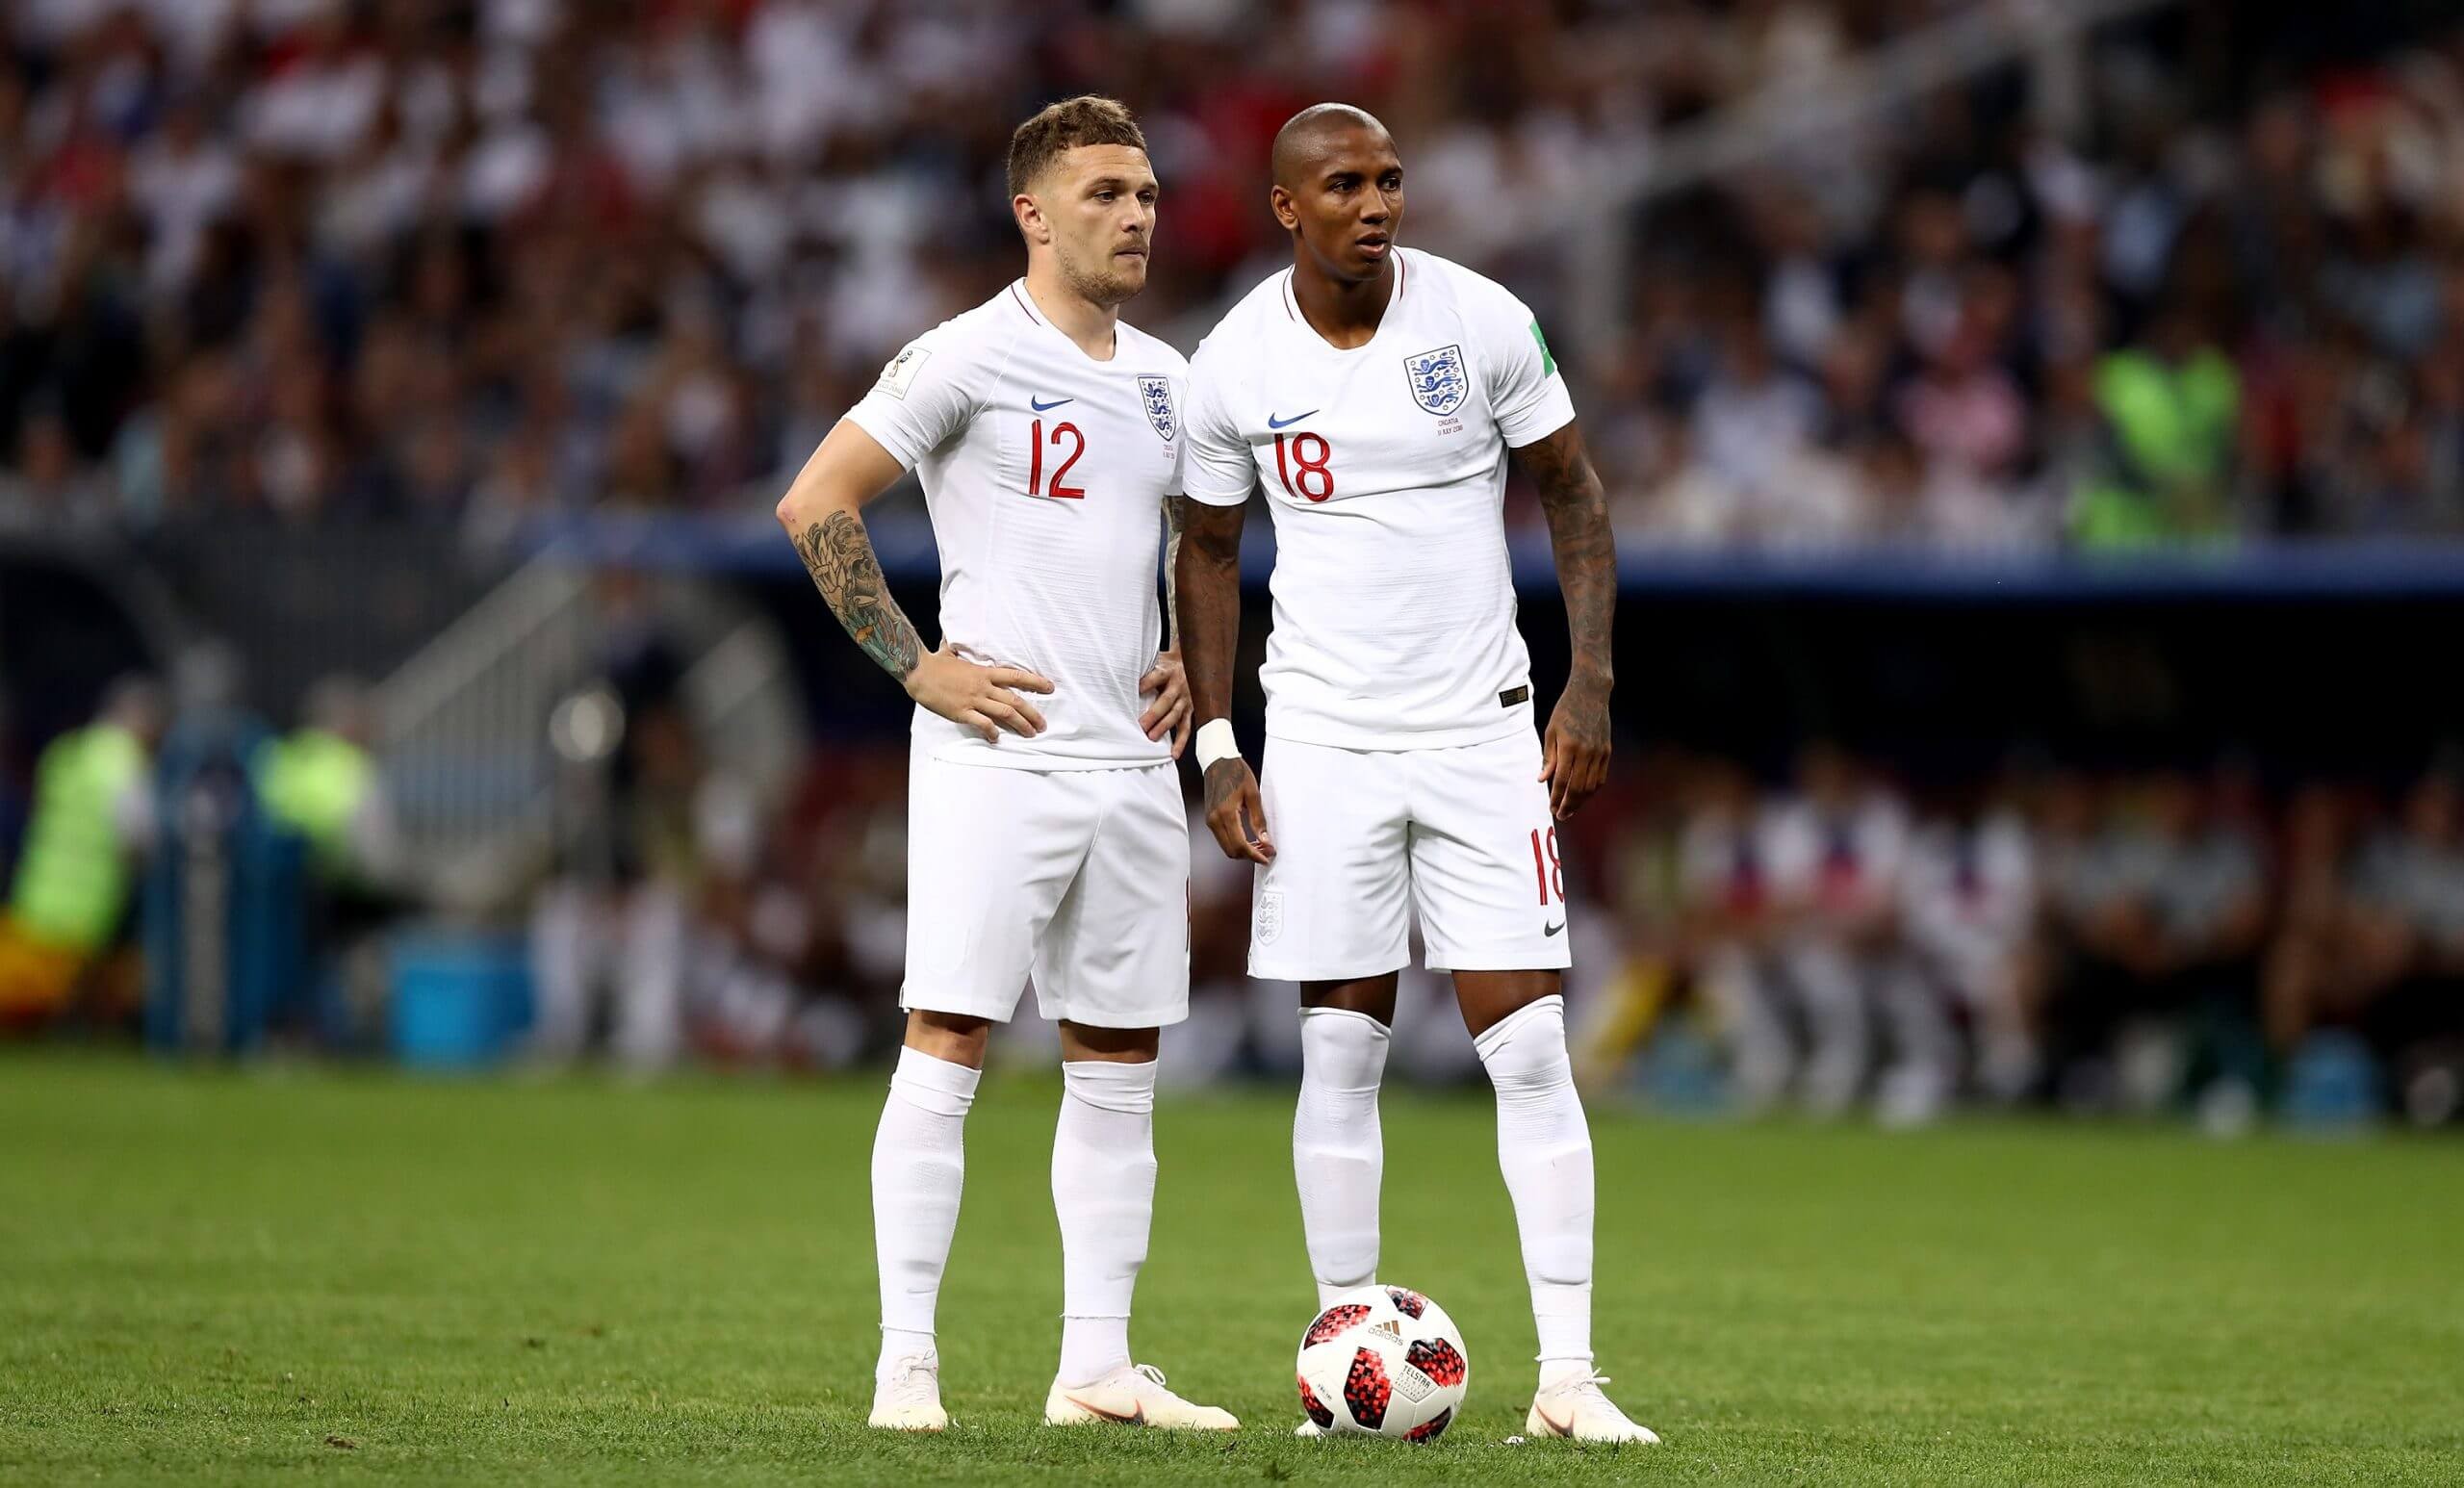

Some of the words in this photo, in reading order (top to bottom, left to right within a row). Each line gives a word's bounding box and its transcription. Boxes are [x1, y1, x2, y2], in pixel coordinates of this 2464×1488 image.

[1029, 421, 1085, 500] 12
[1275, 432, 1334, 501] 18
[1531, 826, 1564, 906] 18
[1368, 1327, 1404, 1347] adidas
[1403, 1365, 1431, 1389] TELSTAR
